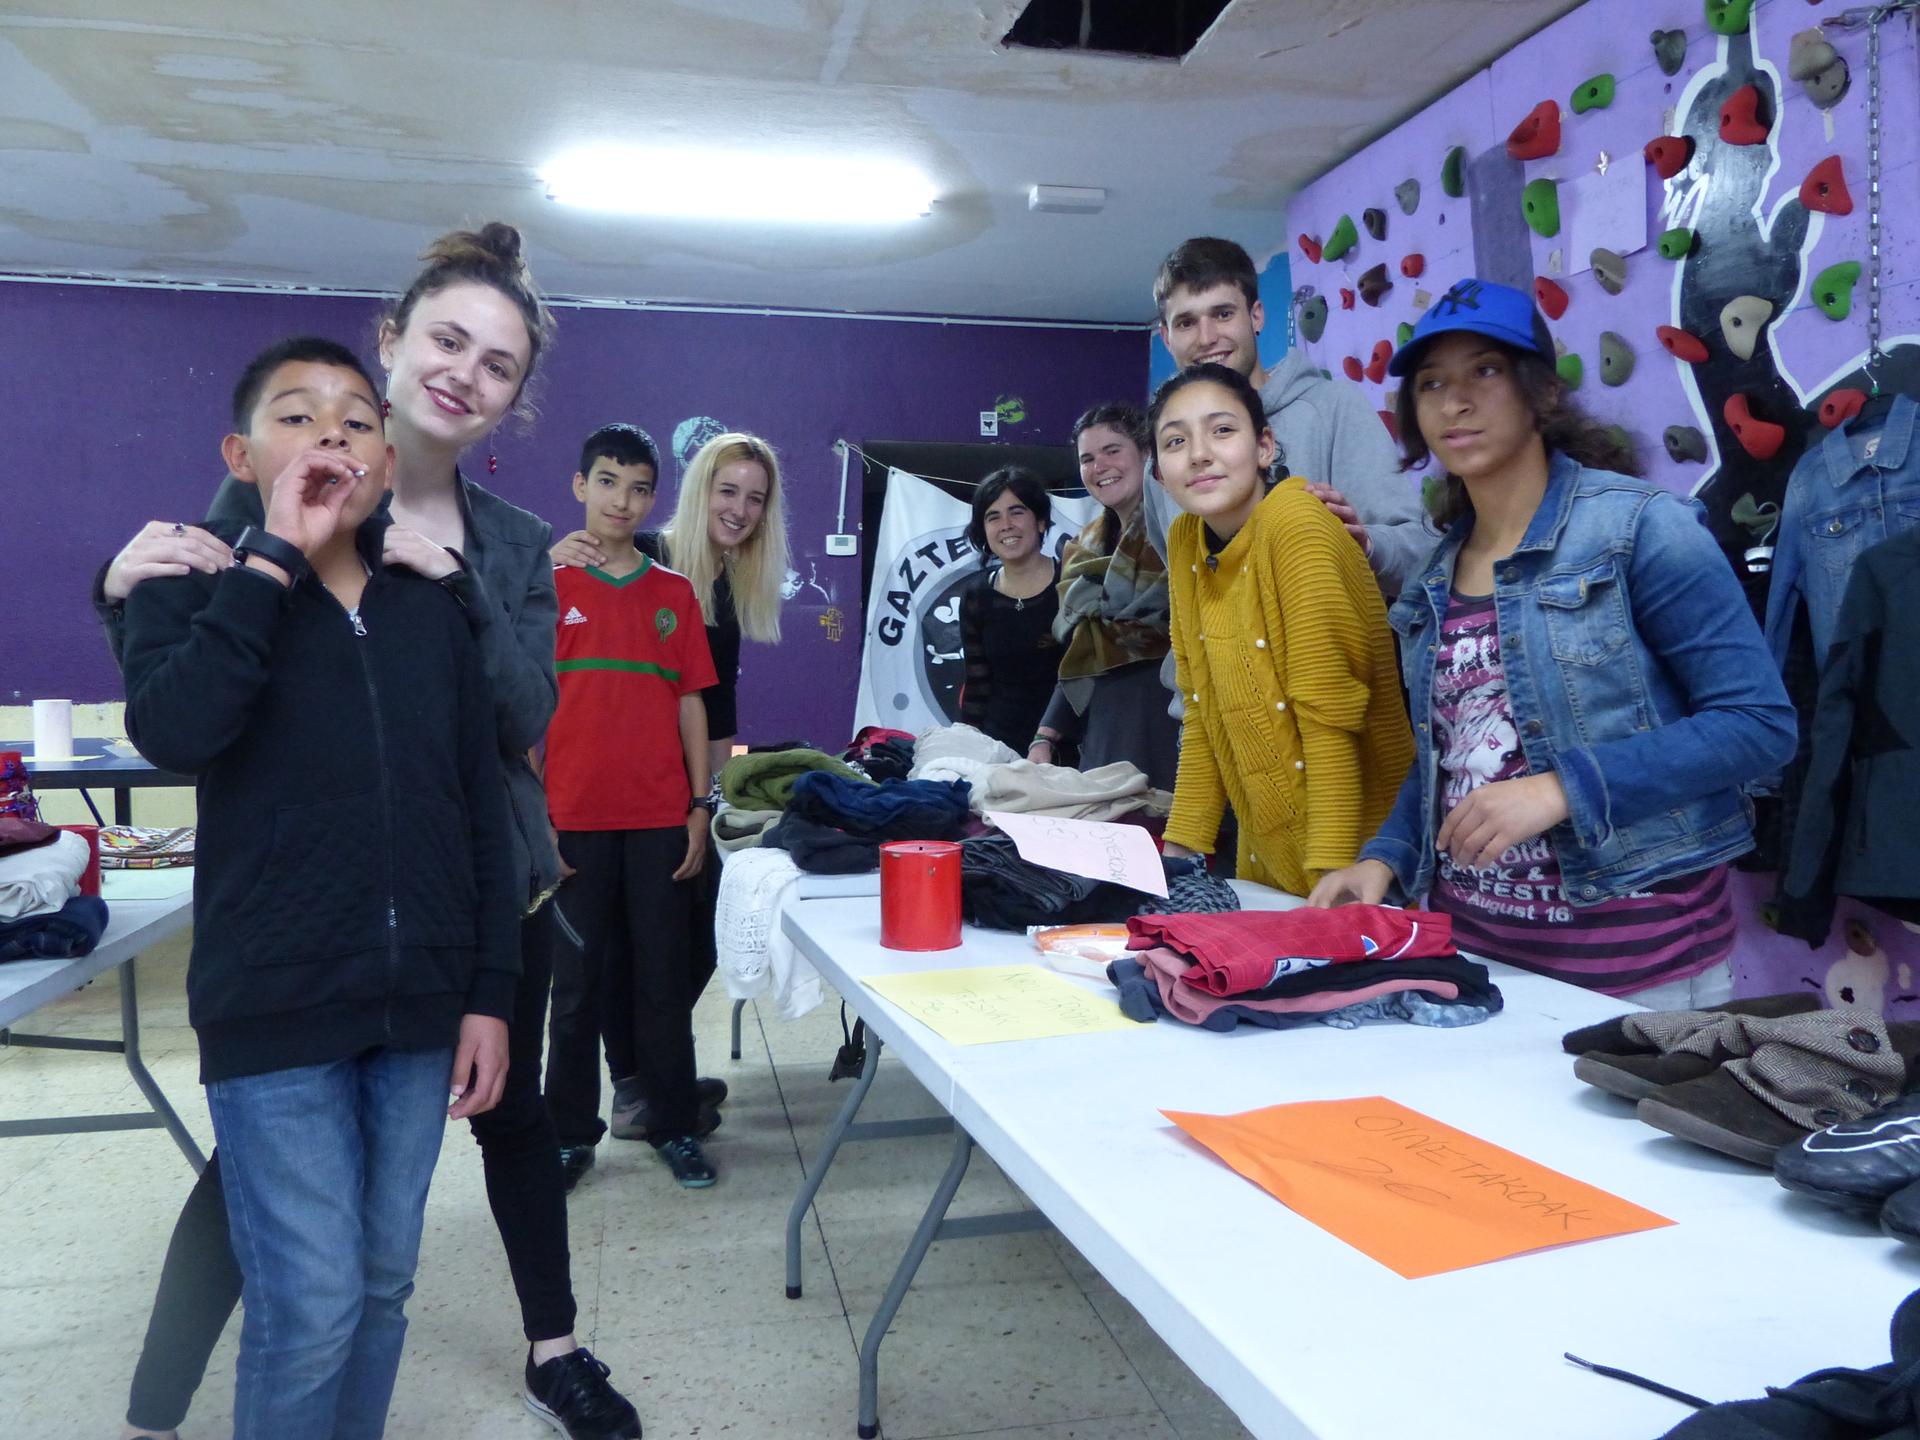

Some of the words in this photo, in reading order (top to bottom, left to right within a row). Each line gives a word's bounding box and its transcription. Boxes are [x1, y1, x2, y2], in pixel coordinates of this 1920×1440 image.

[1528, 866, 1545, 881] &
[1466, 891, 1535, 920] August
[1545, 906, 1570, 922] 16
[1355, 1116, 1592, 1230] OINETAKOAK
